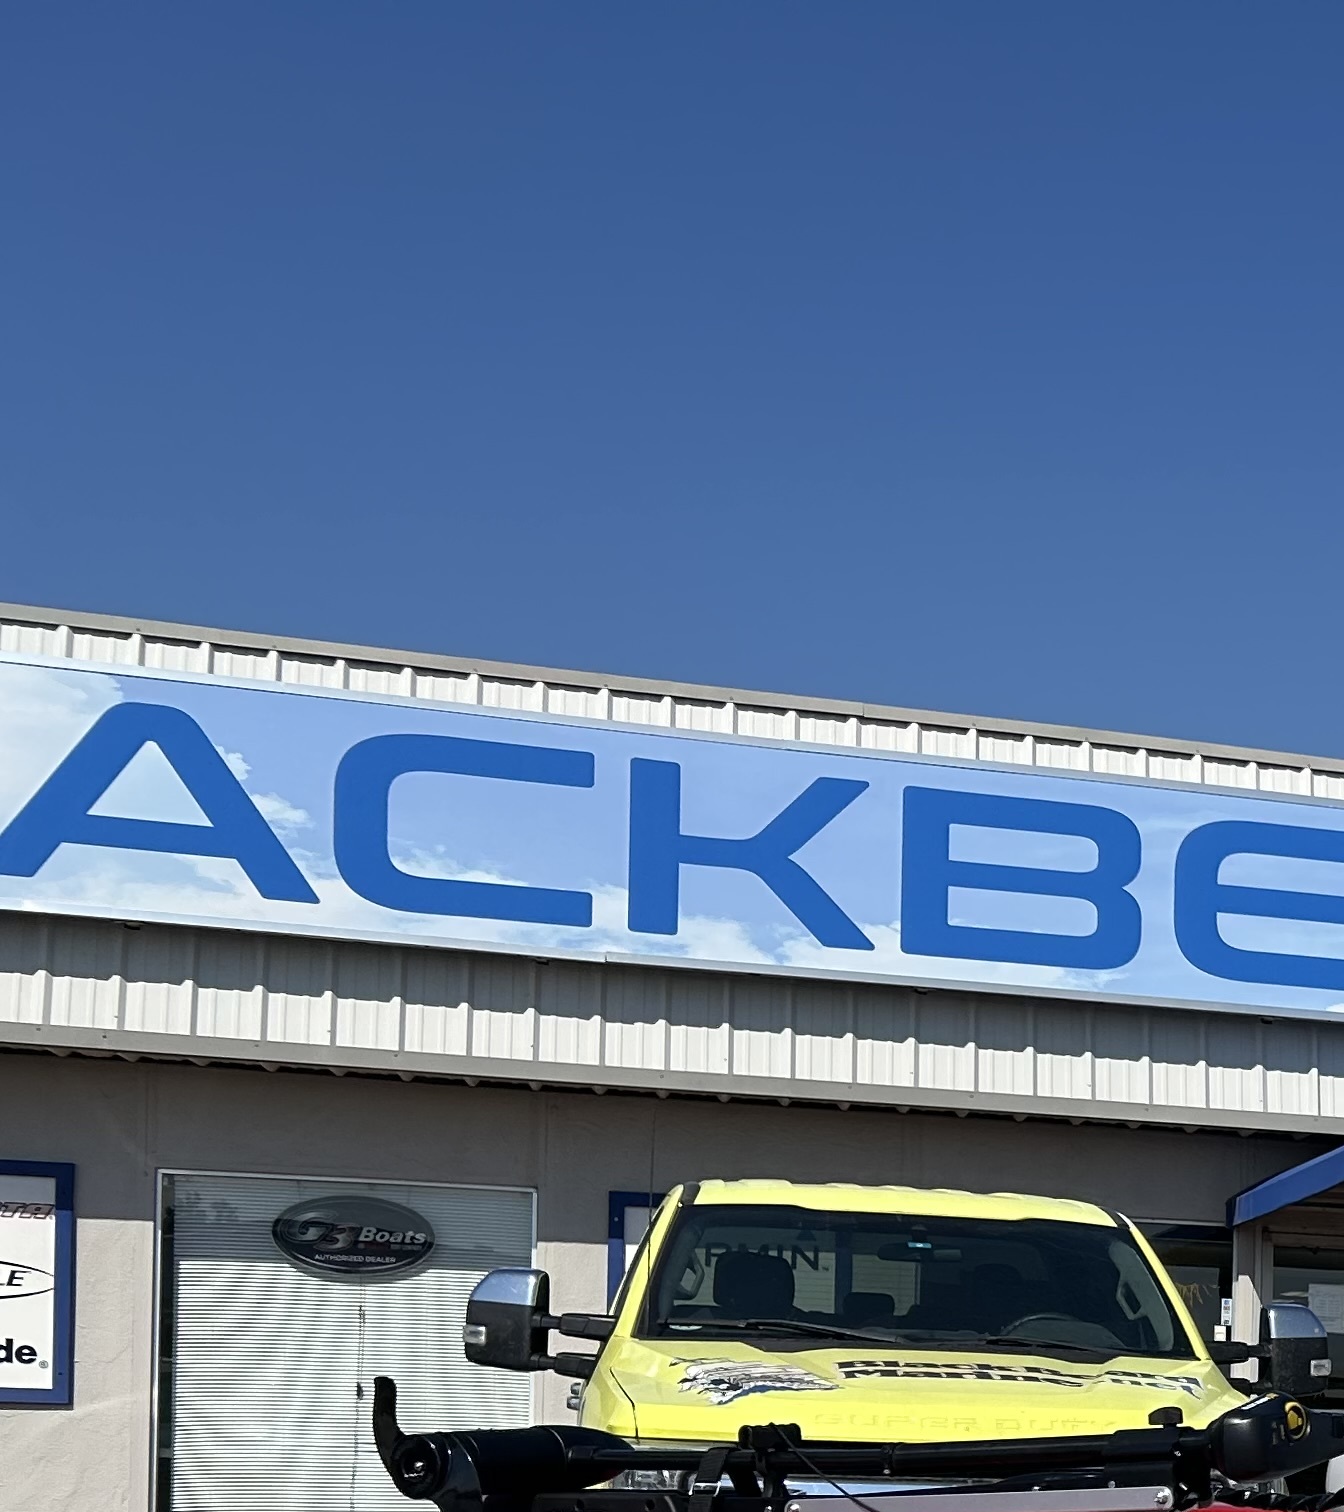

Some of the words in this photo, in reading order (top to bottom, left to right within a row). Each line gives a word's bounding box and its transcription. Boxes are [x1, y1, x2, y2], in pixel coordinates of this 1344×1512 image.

[358, 1226, 427, 1244] Boats
[314, 1254, 364, 1263] AUTHORIZED
[365, 1255, 397, 1264] DEALER
